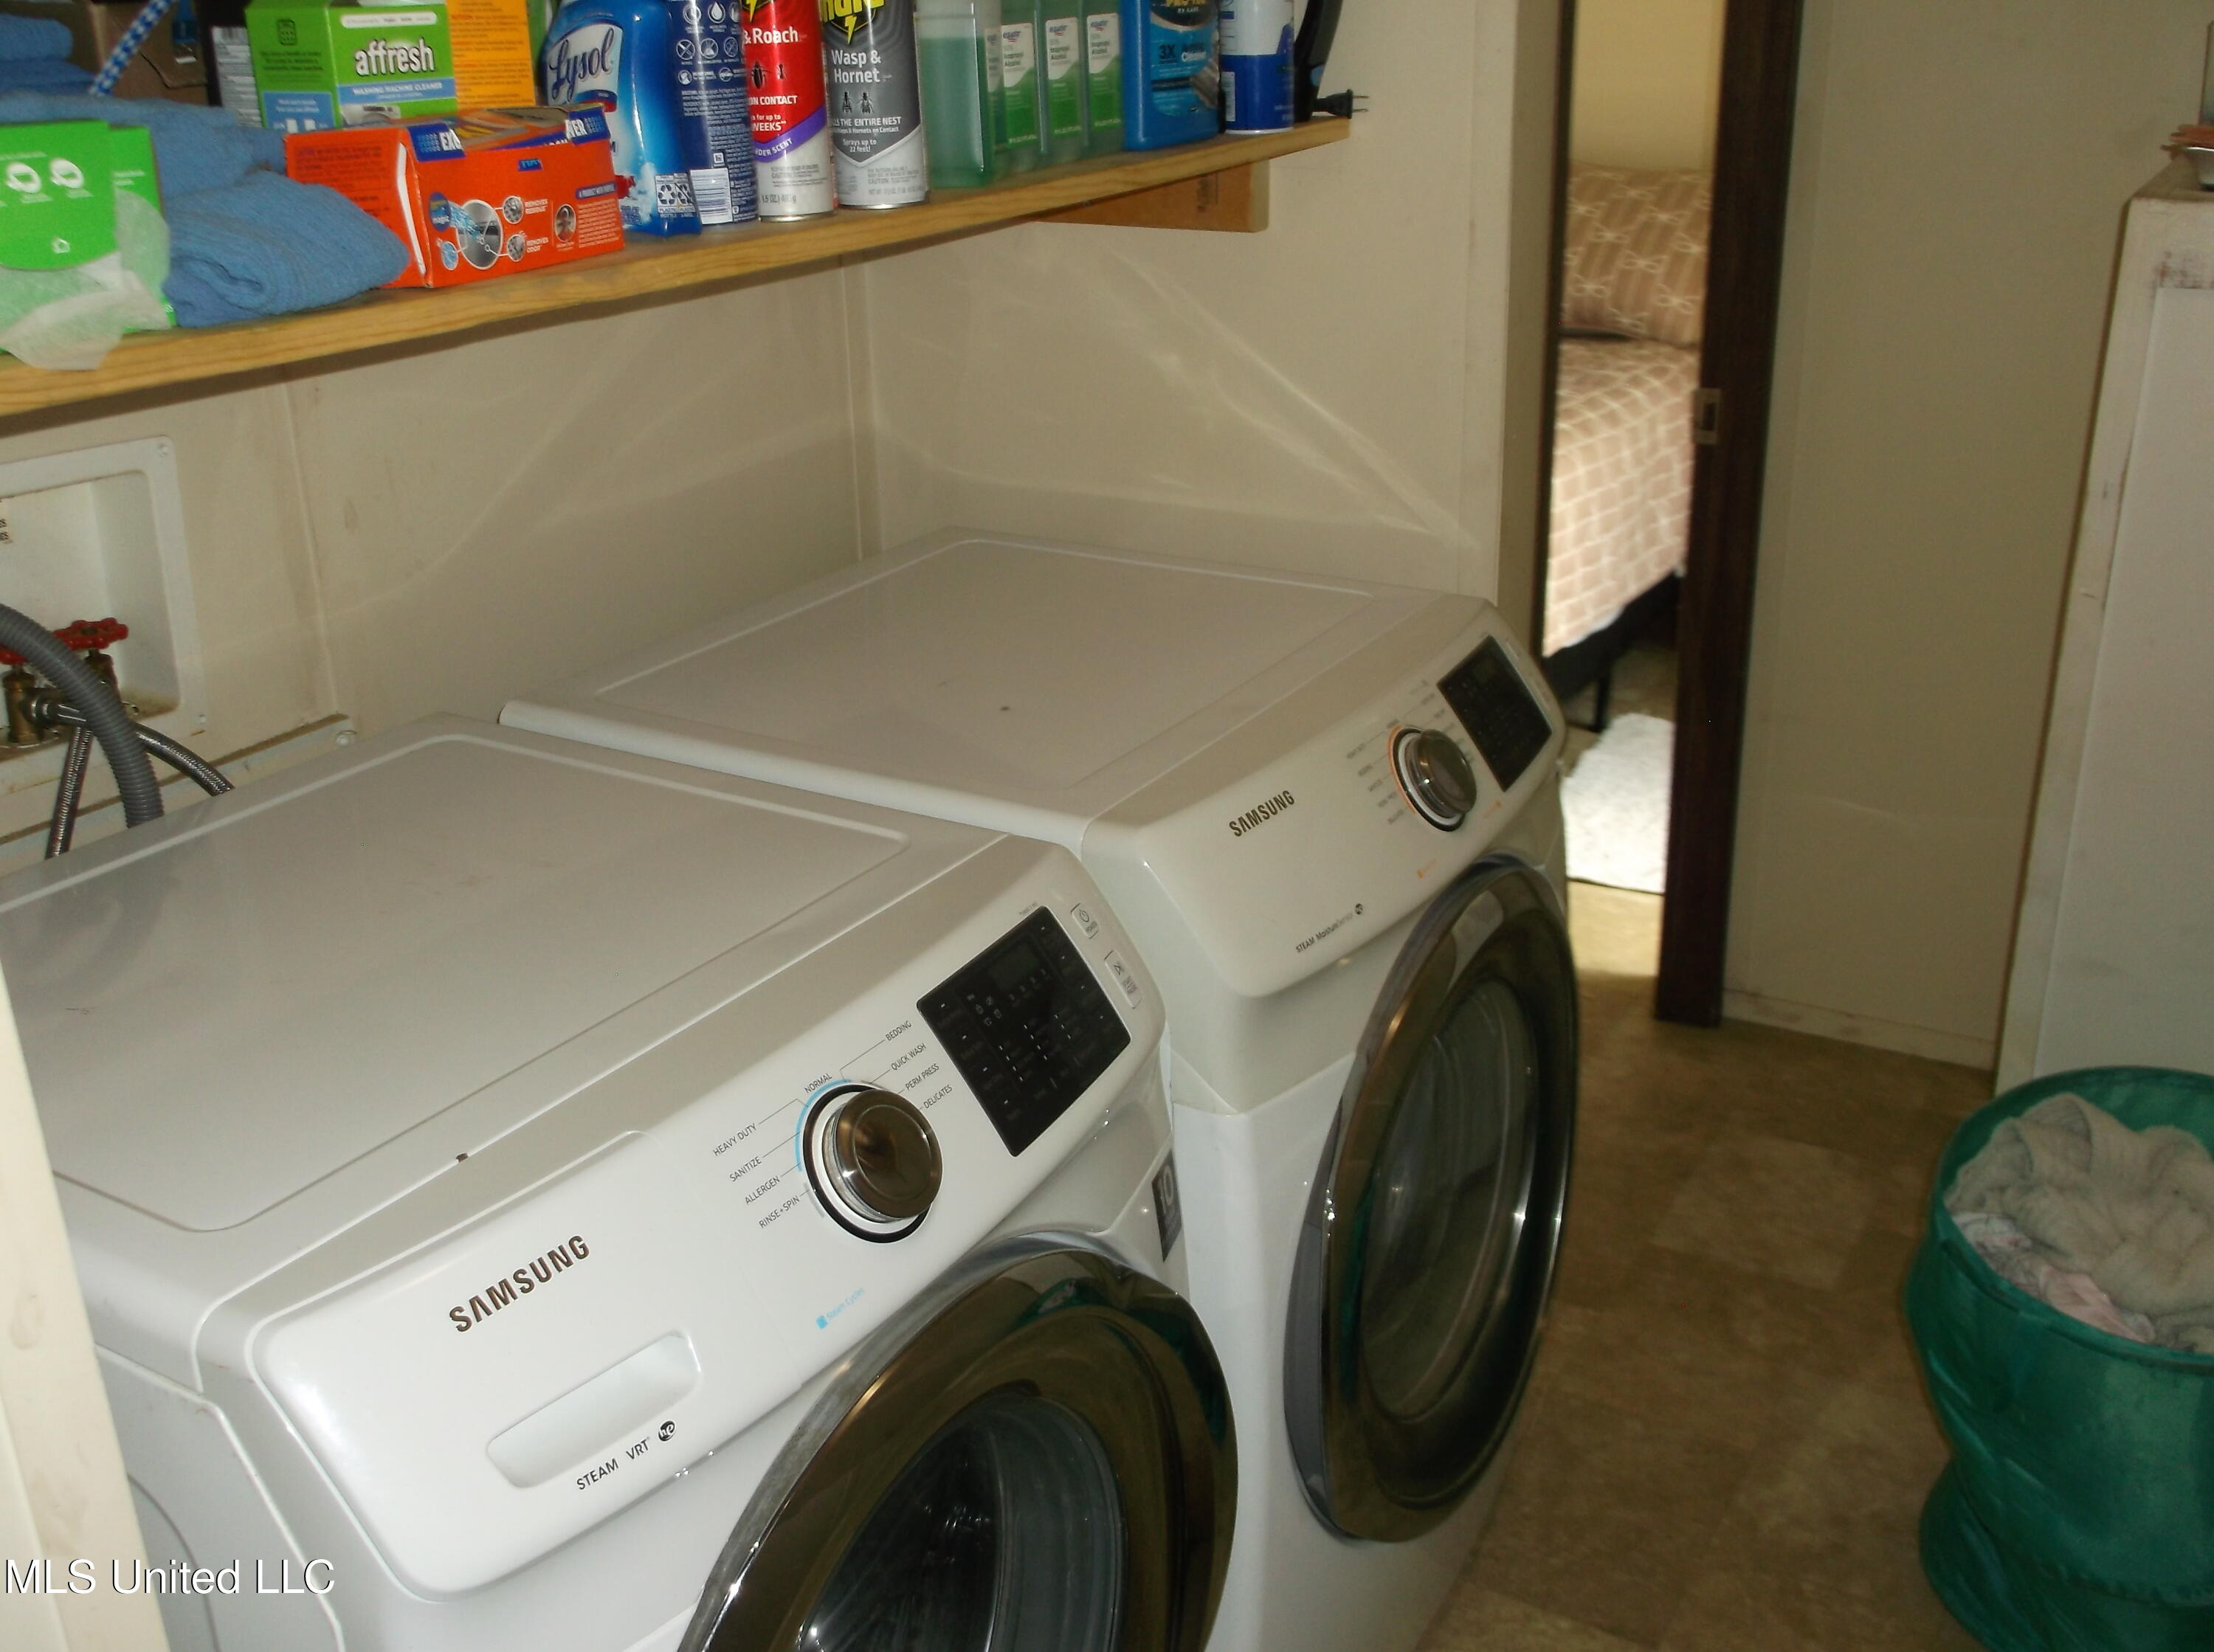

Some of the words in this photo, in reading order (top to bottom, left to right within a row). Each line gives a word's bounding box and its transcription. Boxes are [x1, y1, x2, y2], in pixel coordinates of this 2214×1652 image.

[753, 25, 799, 44] Roach
[354, 37, 436, 77] affresh
[831, 49, 868, 68] Wasp
[871, 49, 881, 64] &
[1159, 44, 1176, 59] 3X
[549, 27, 614, 103] Lysol
[834, 68, 880, 83] Hornet
[759, 95, 798, 105] CONTACT
[841, 118, 852, 126] THE
[854, 117, 882, 127] ENTIRE
[883, 116, 902, 125] NEST
[772, 138, 793, 153] SCENT
[1228, 789, 1295, 837] SAMSUNG
[1295, 936, 1316, 954] STEAM
[885, 1020, 912, 1042] BEDDING
[891, 1054, 910, 1071] QUICK
[908, 1043, 927, 1058] WASH
[804, 1072, 833, 1094] NORMAL
[905, 1076, 922, 1091] PERM
[921, 1062, 939, 1079] PRESS
[922, 1084, 953, 1109] DELICATES
[713, 1136, 739, 1157] HEAVY
[737, 1122, 758, 1140] DUTY
[729, 1155, 762, 1183] SANITIZE
[745, 1175, 781, 1205] ALLERGEN
[449, 1235, 590, 1333] SAMSUNG
[576, 1457, 619, 1490] STEAM
[625, 1439, 649, 1460] VRT
